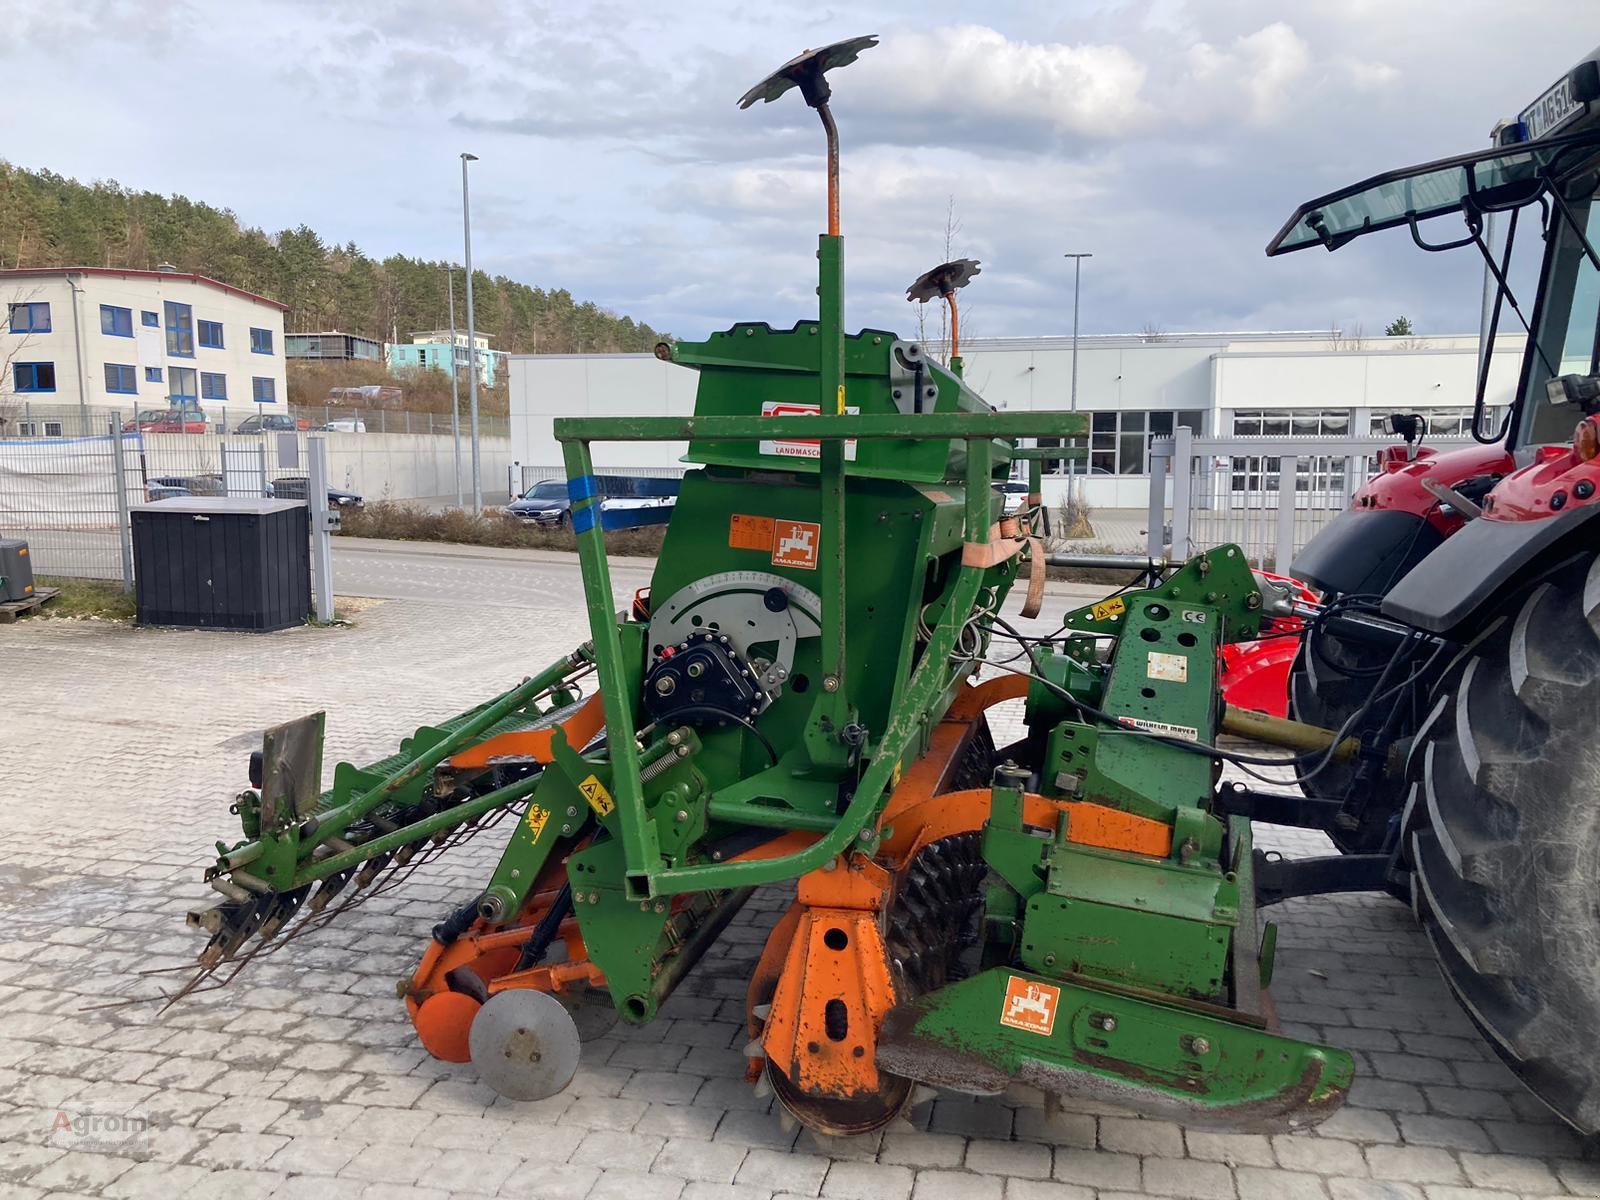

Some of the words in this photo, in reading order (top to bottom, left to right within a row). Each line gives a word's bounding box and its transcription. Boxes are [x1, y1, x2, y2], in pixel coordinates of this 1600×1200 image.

[775, 446, 821, 457] LANDMASCH
[773, 557, 815, 568] AMAZONE
[1136, 720, 1168, 731] WILHELM
[1170, 725, 1196, 735] MAYER
[1003, 1016, 1051, 1033] AMAZONE
